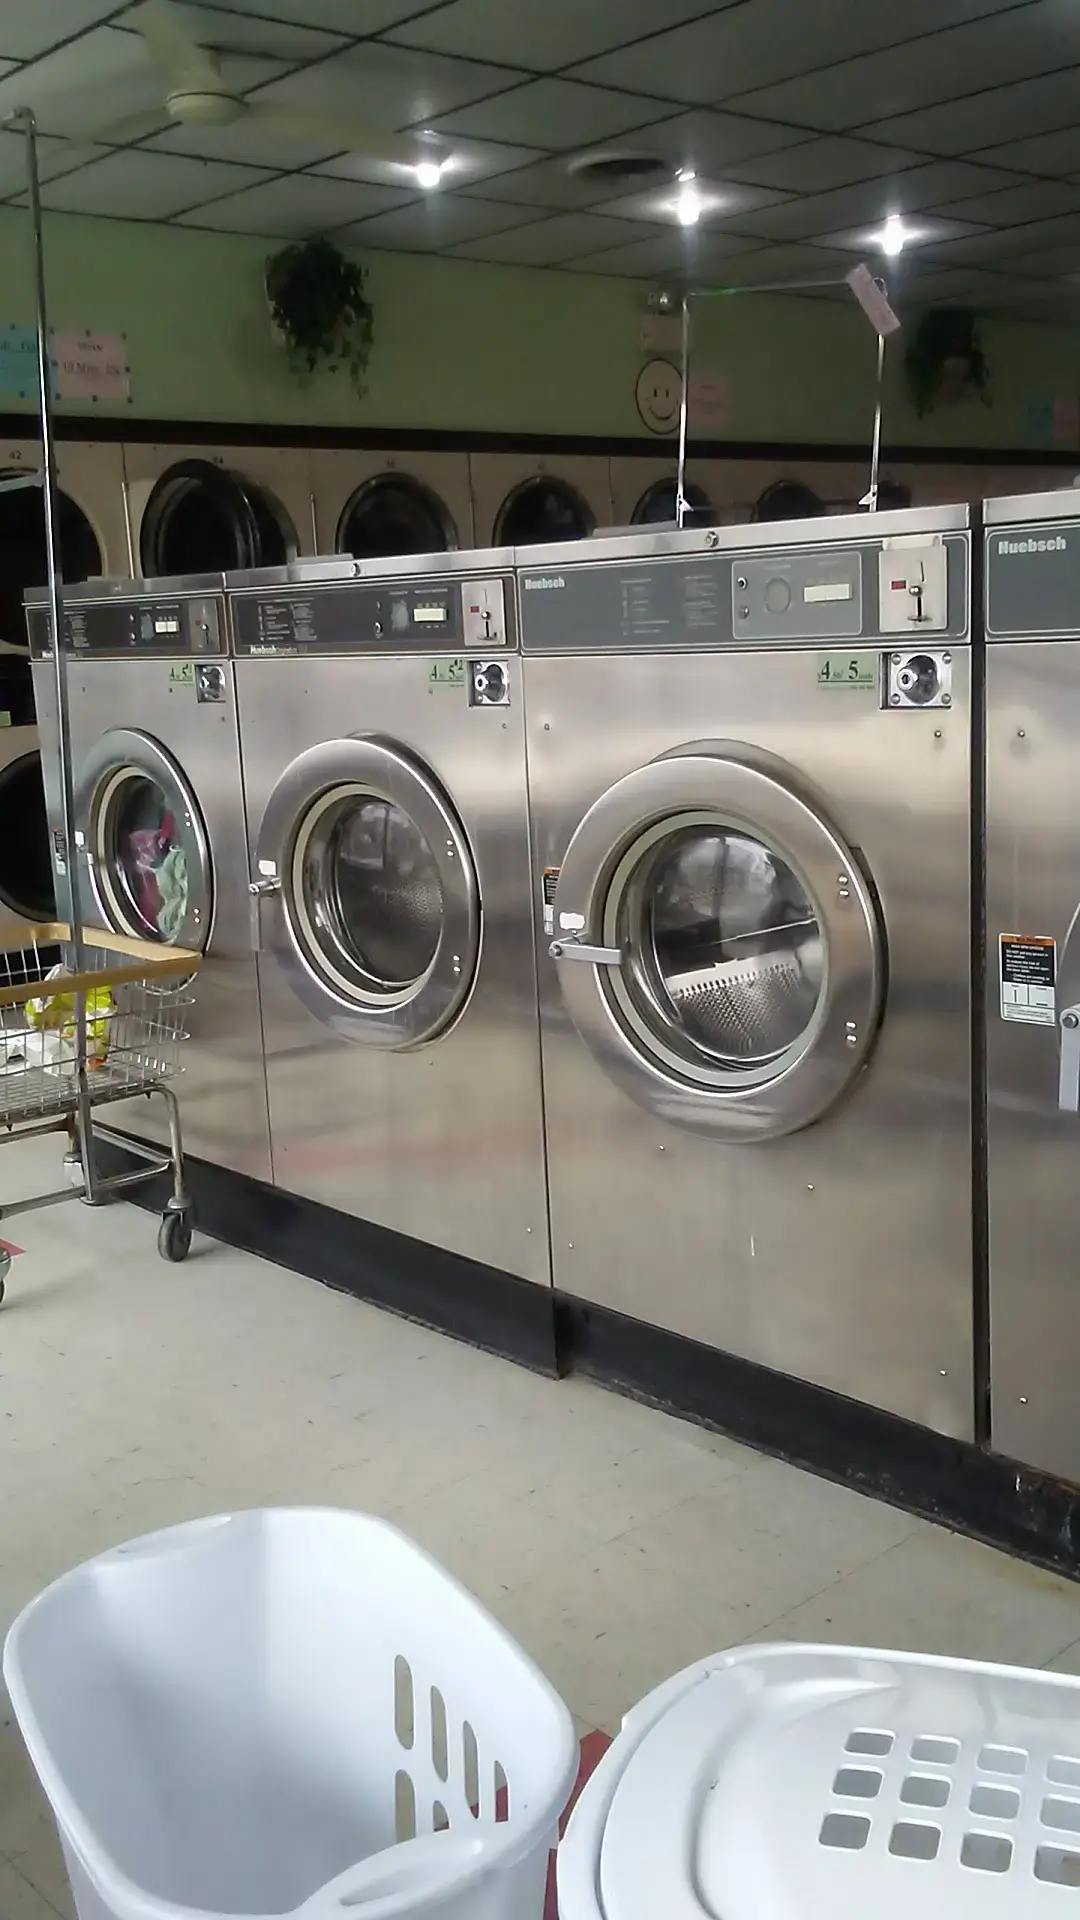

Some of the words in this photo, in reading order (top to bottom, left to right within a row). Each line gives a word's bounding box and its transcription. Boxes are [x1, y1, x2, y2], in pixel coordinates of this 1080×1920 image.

[998, 536, 1067, 555] Huebsch
[524, 577, 565, 590] Huebsch
[848, 660, 858, 680] 5
